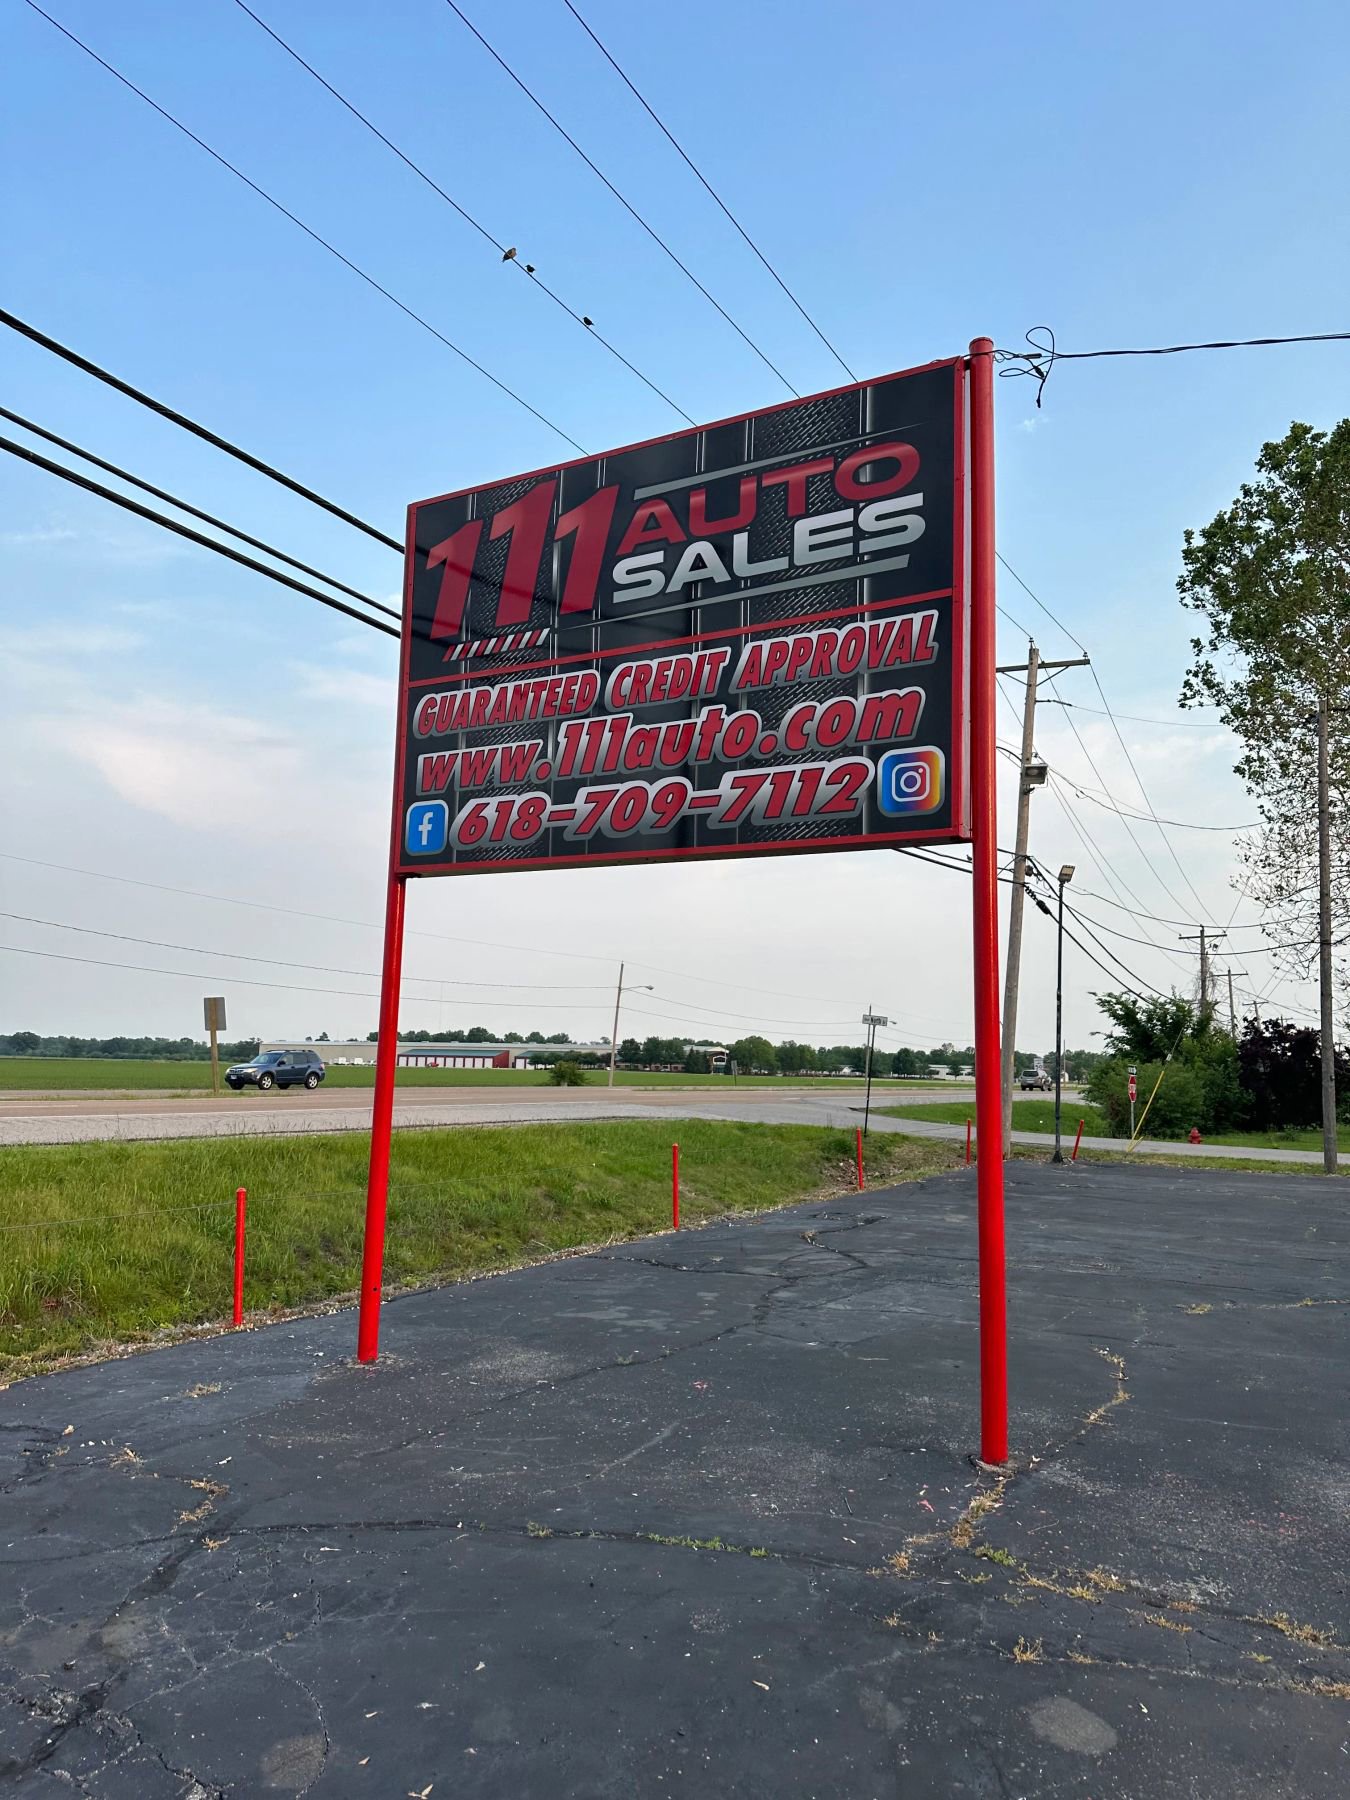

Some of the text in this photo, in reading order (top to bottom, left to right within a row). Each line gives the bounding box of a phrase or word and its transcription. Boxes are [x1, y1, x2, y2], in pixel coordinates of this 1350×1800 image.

[612, 493, 926, 604] SALES
[615, 442, 920, 556] AUTO
[426, 479, 620, 640] 111
[415, 612, 937, 737] GUARANTEED CREDIT APPROVAL
[419, 688, 924, 793] www.111auto.com
[454, 759, 873, 847] 618-709-7112
